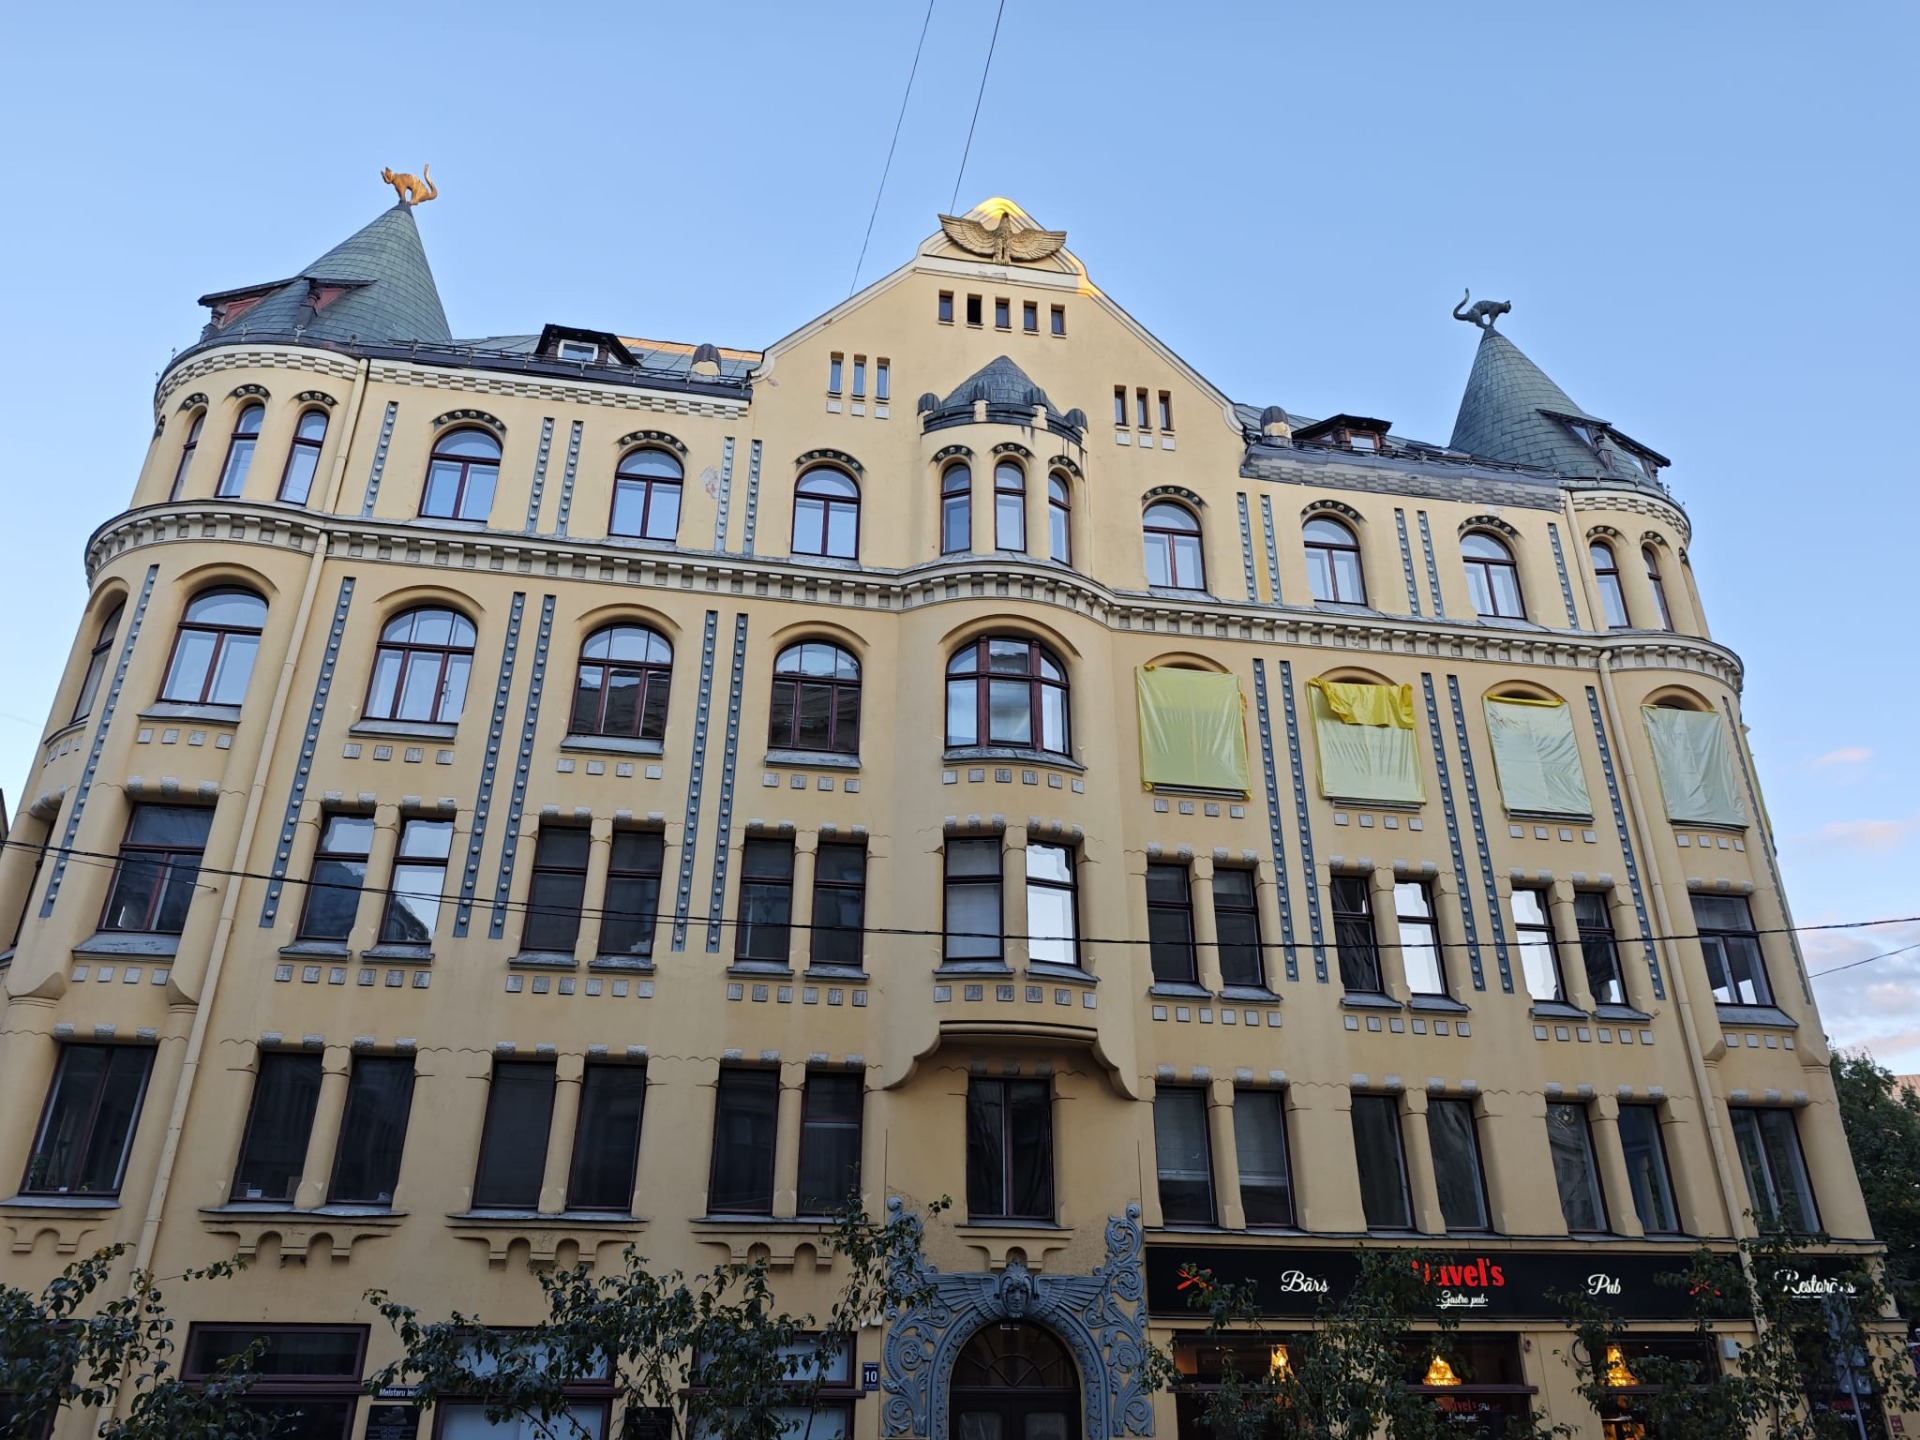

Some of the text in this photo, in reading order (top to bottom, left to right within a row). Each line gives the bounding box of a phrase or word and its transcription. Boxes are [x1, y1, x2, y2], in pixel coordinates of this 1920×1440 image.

[1280, 1269, 1330, 1293] Bārs
[1587, 1273, 1621, 1296] Pub
[1470, 1292, 1486, 1309] pub
[864, 1370, 878, 1383] 10
